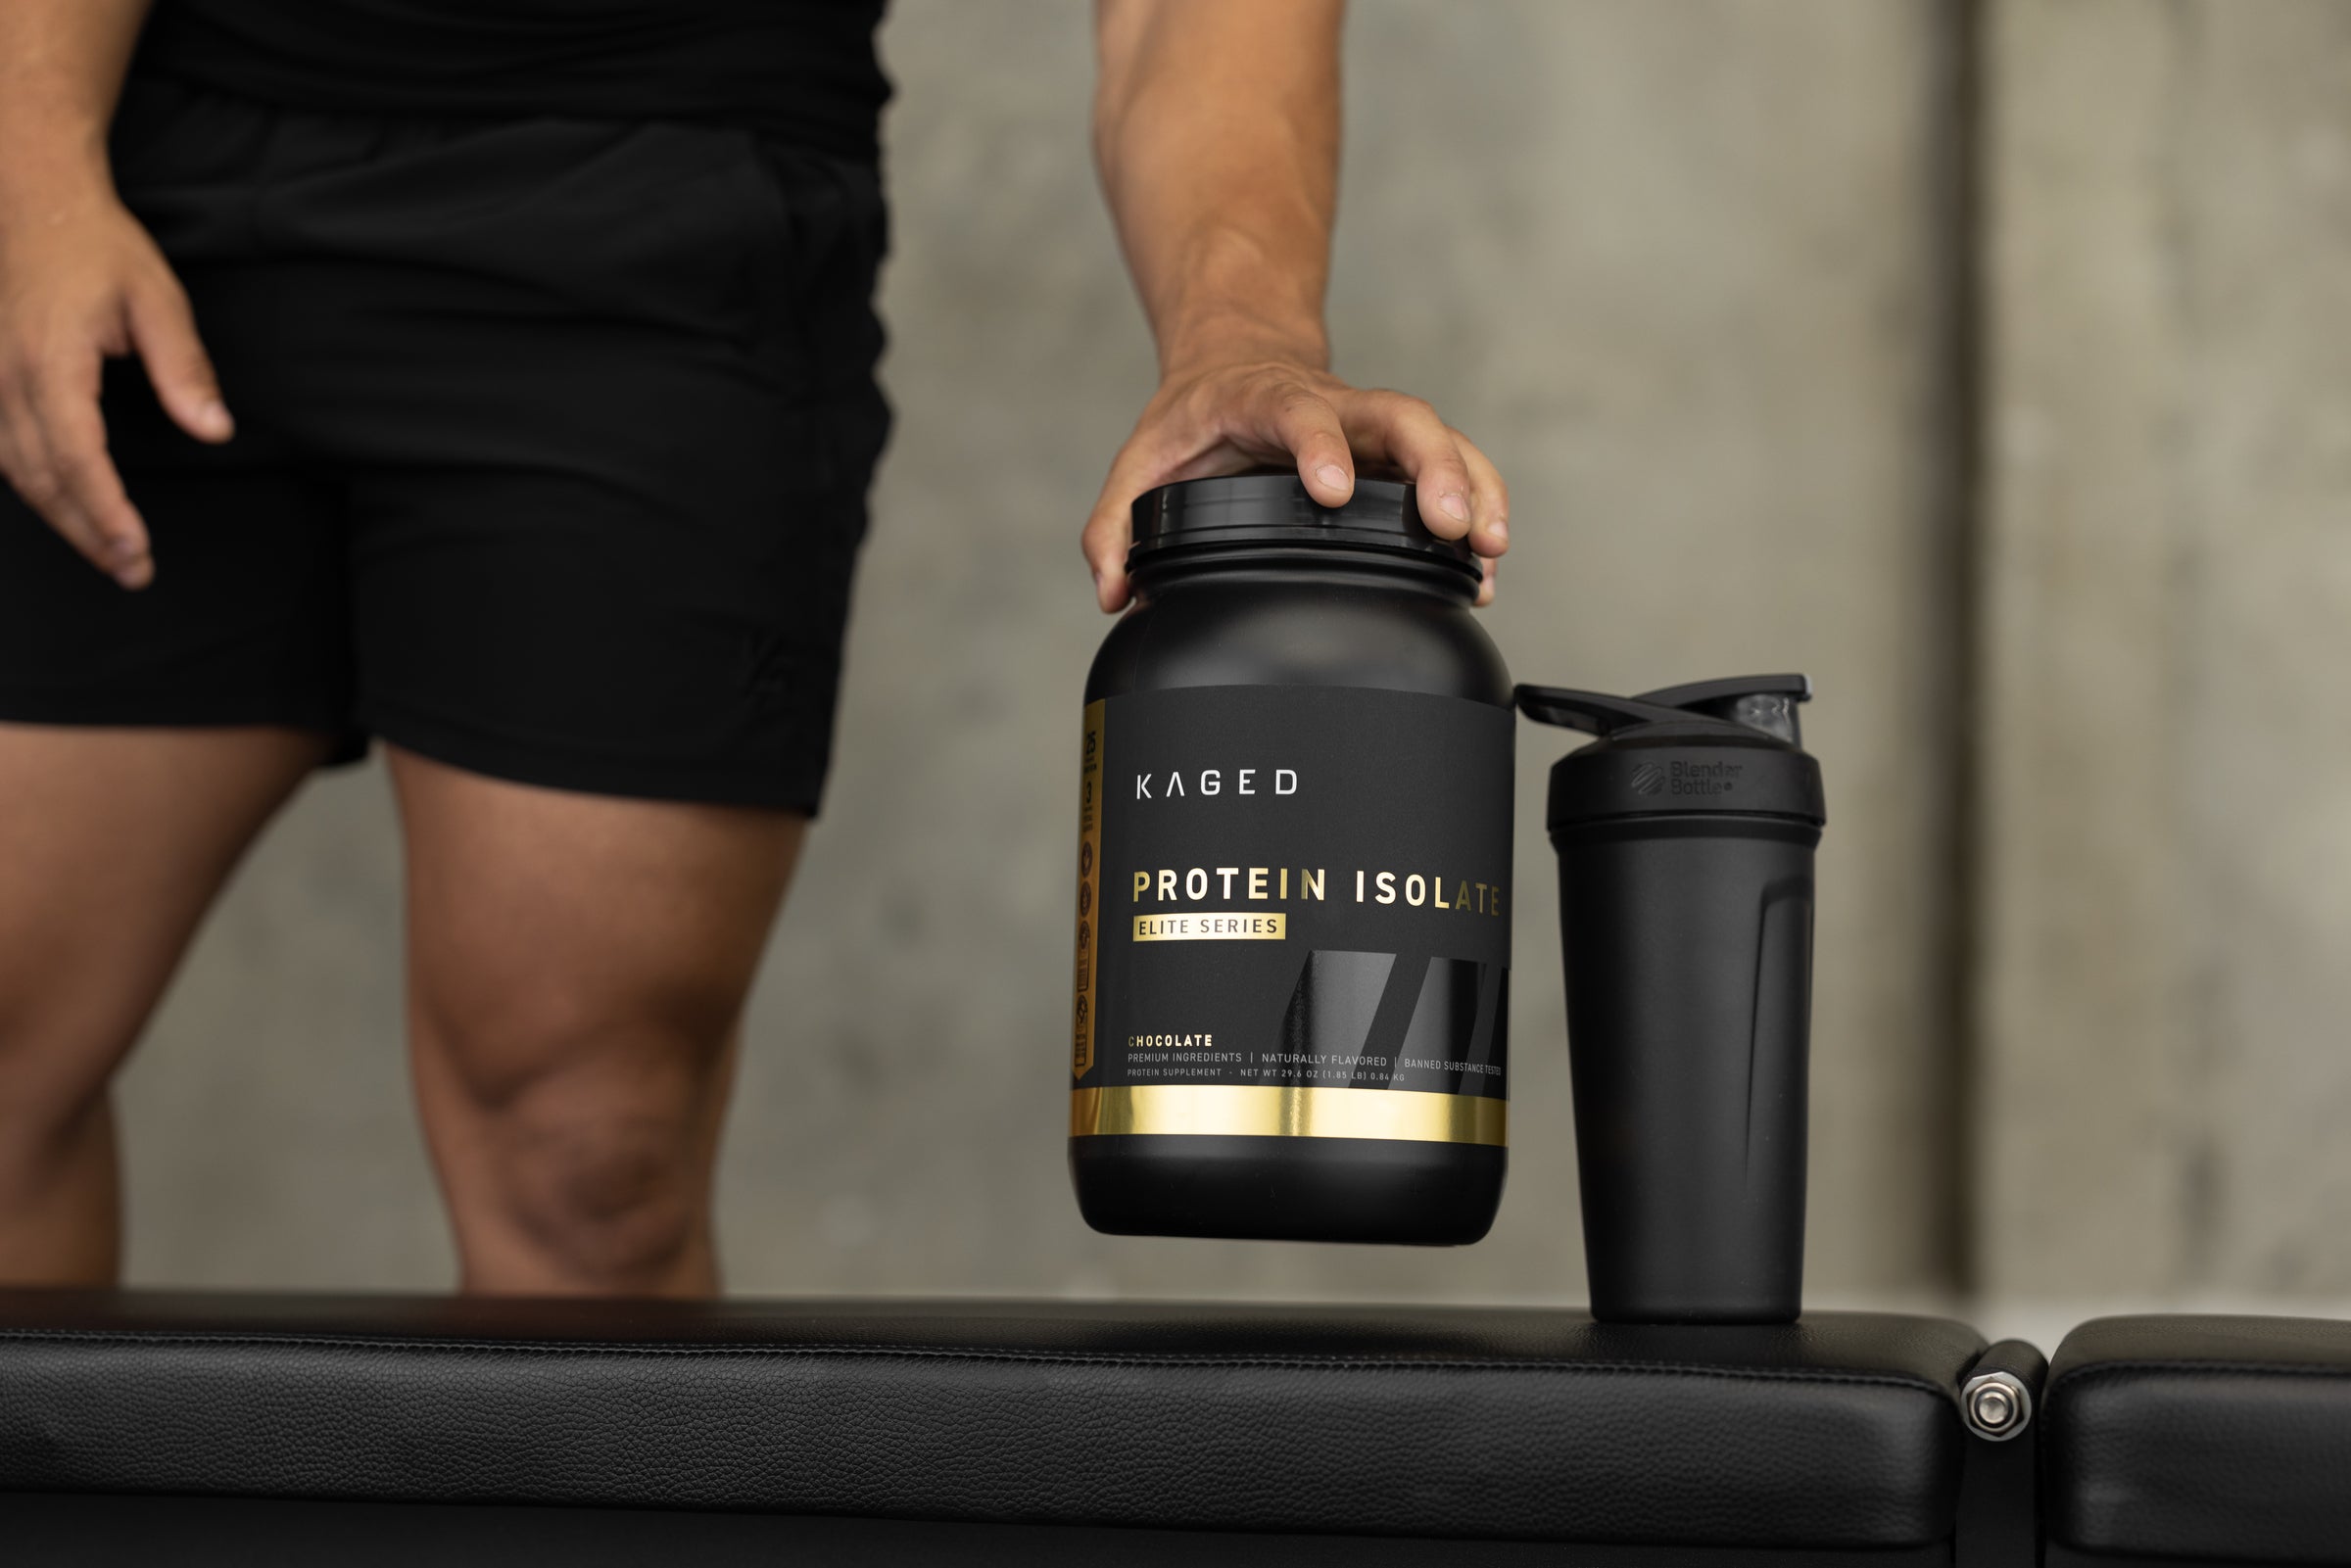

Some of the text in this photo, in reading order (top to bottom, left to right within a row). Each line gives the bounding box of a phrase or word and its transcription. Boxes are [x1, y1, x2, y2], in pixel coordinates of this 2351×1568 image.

[1670, 761, 1743, 778] Blender
[1136, 769, 1298, 799] KAGED
[1133, 868, 1501, 917] PROTEIN ISOLATE
[1138, 918, 1278, 936] ELITE SERIES
[1128, 1034, 1213, 1047] CHOCOLATE
[1128, 1052, 1502, 1076] PREMIUM INGREDIENTS NATURALLY FLAVORED BANNED SUBSTANCE TESTED
[1127, 1069, 1160, 1077] PROTEIN
[1163, 1068, 1223, 1076] SUPPLEMENT
[1240, 1069, 1259, 1077] NET
[1263, 1069, 1277, 1078] WT
[1281, 1069, 1302, 1078] 29.6
[1306, 1069, 1319, 1078] OZ
[1370, 1072, 1389, 1081] 0.84
[1393, 1073, 1405, 1082] KG
